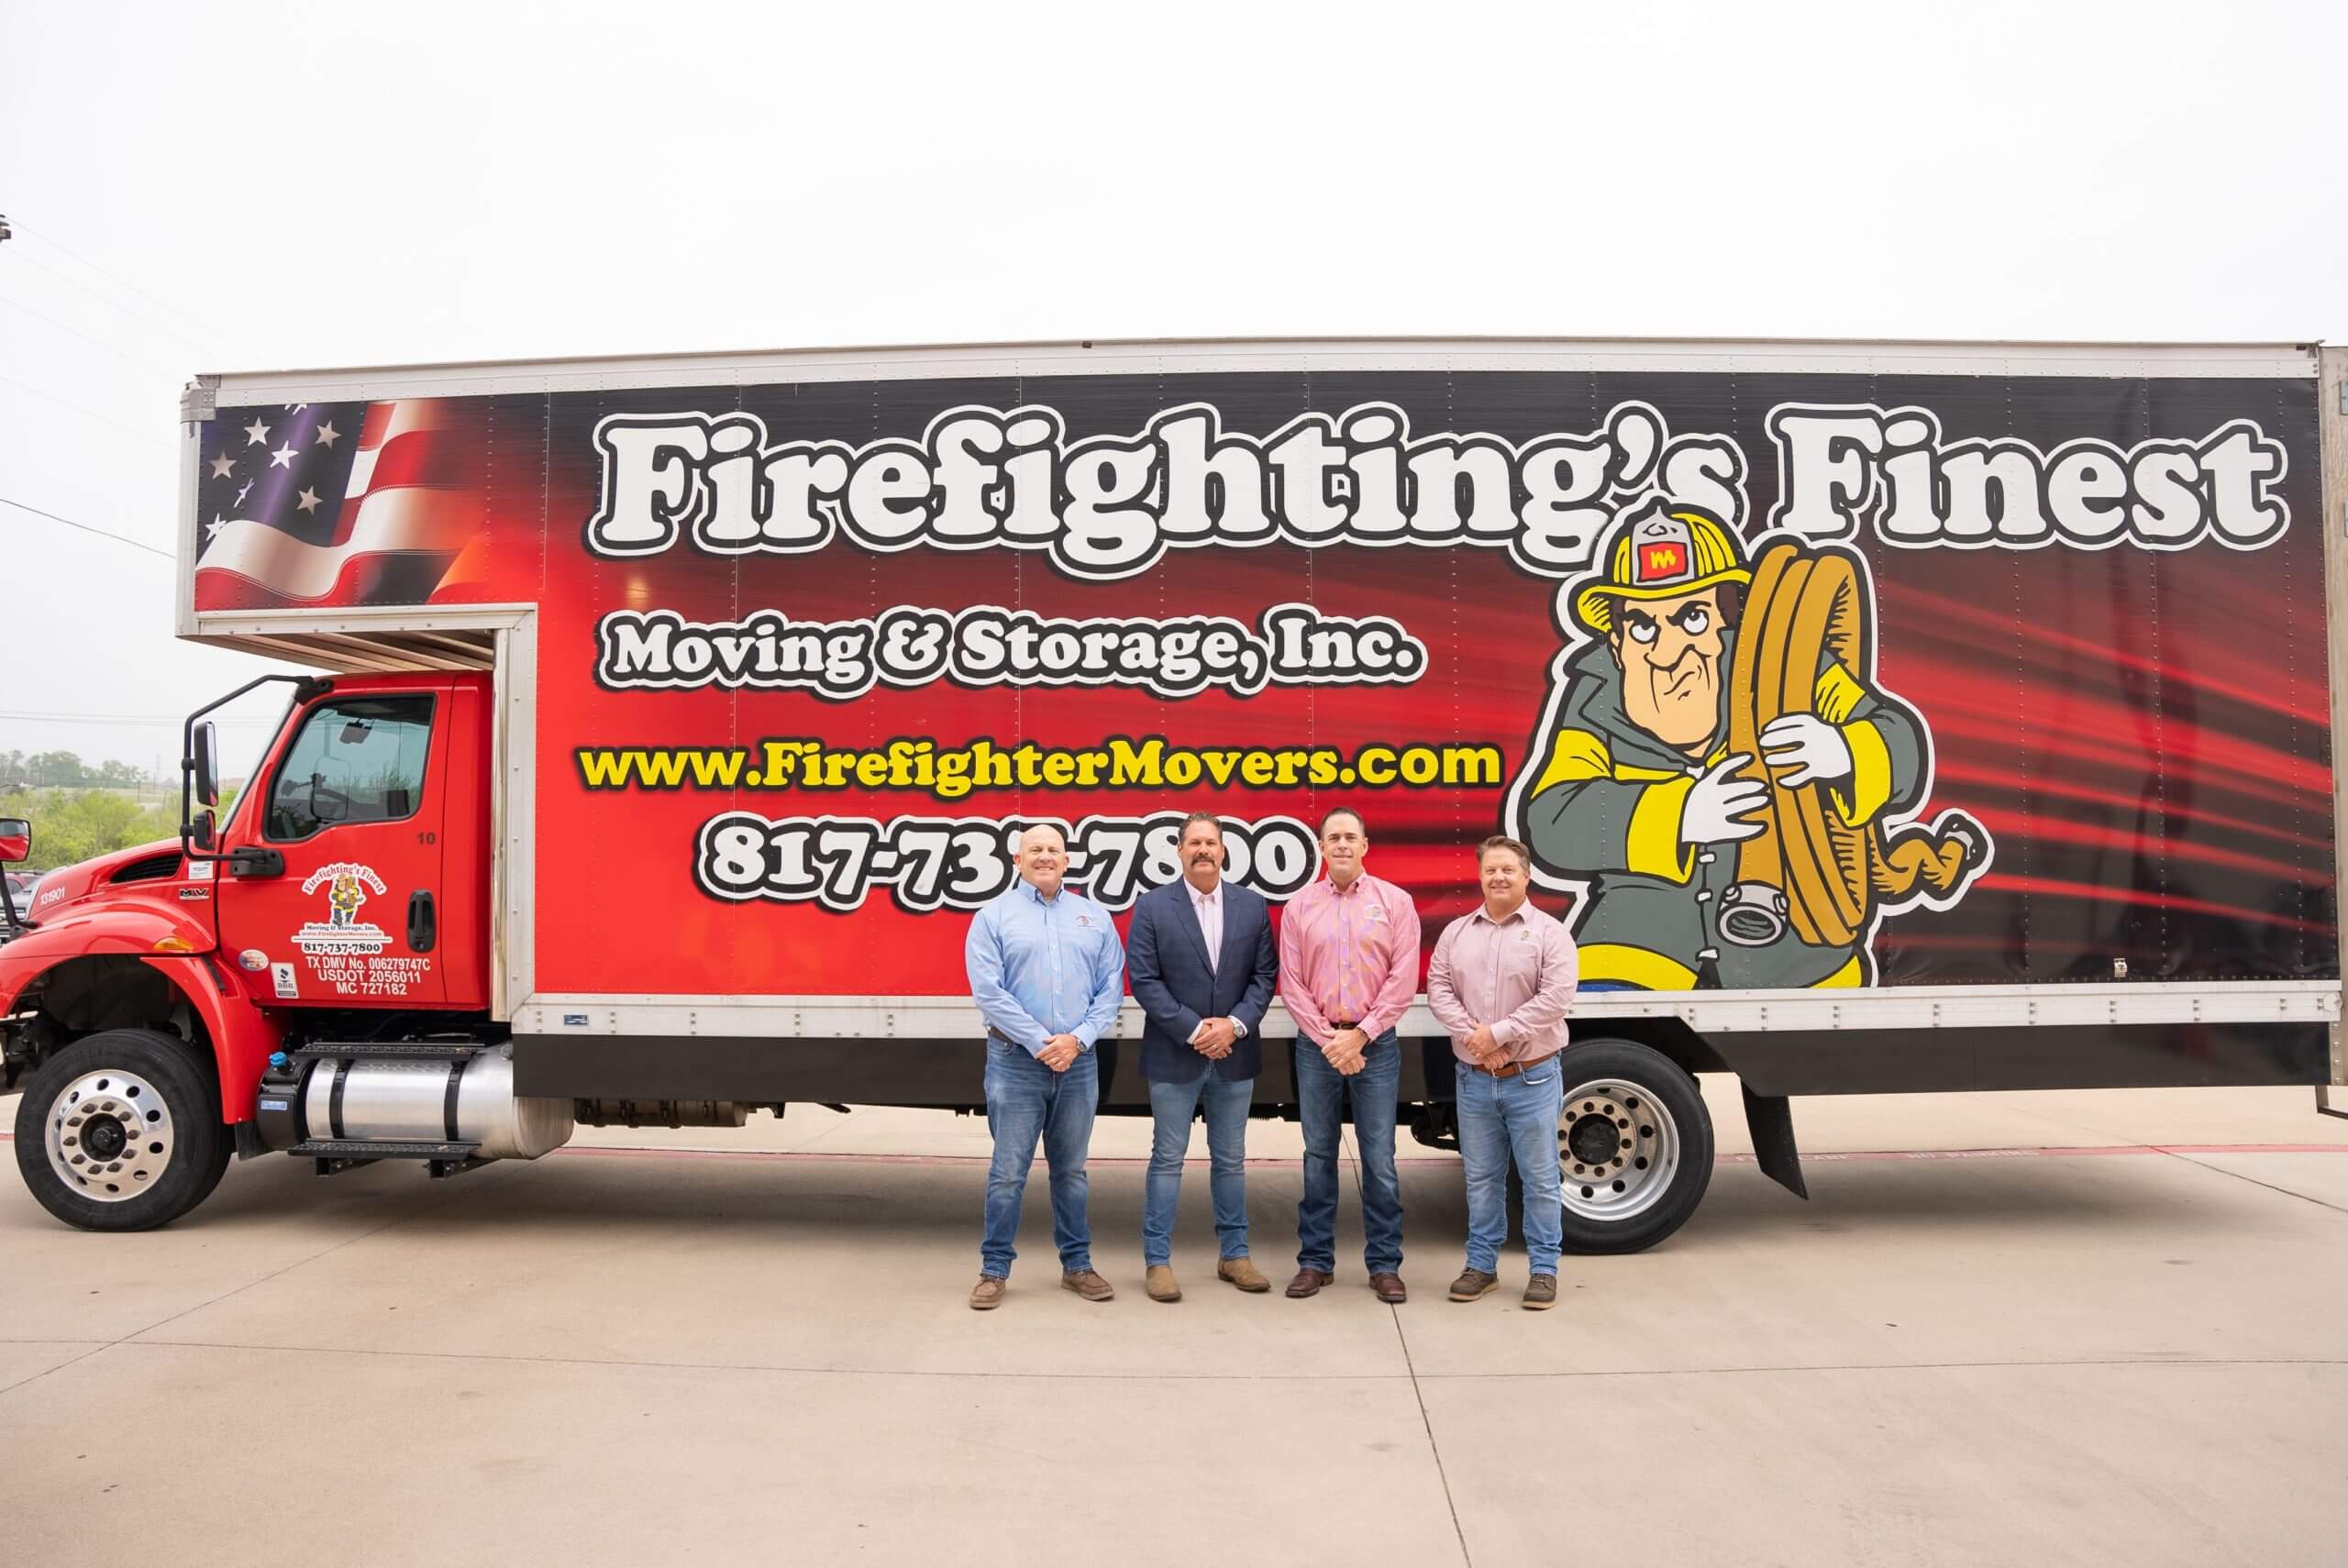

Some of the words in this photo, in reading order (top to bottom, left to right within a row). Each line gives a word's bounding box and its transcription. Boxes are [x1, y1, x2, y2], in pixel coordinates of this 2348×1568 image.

[596, 410, 1741, 570] Firefighting's
[1774, 411, 2282, 542] Finest
[610, 620, 869, 687] Moving
[877, 615, 949, 675] &
[957, 615, 1262, 683] Storage,
[1275, 613, 1419, 672] Inc.
[578, 738, 1502, 799] www.FirefighterMovers.com
[417, 831, 437, 845] 10
[708, 820, 1312, 900] 817-73-7800
[304, 865, 360, 892] Firefighting's
[361, 867, 384, 892] Finest
[304, 943, 381, 953] 817-737-7800
[305, 955, 321, 969] TX
[322, 956, 346, 969] DMV
[349, 956, 367, 970] No.
[369, 957, 431, 971] 006279747C
[317, 969, 365, 982] USDOT
[369, 970, 421, 983] 2056011
[336, 982, 358, 994] MC
[360, 983, 407, 996] 727182
